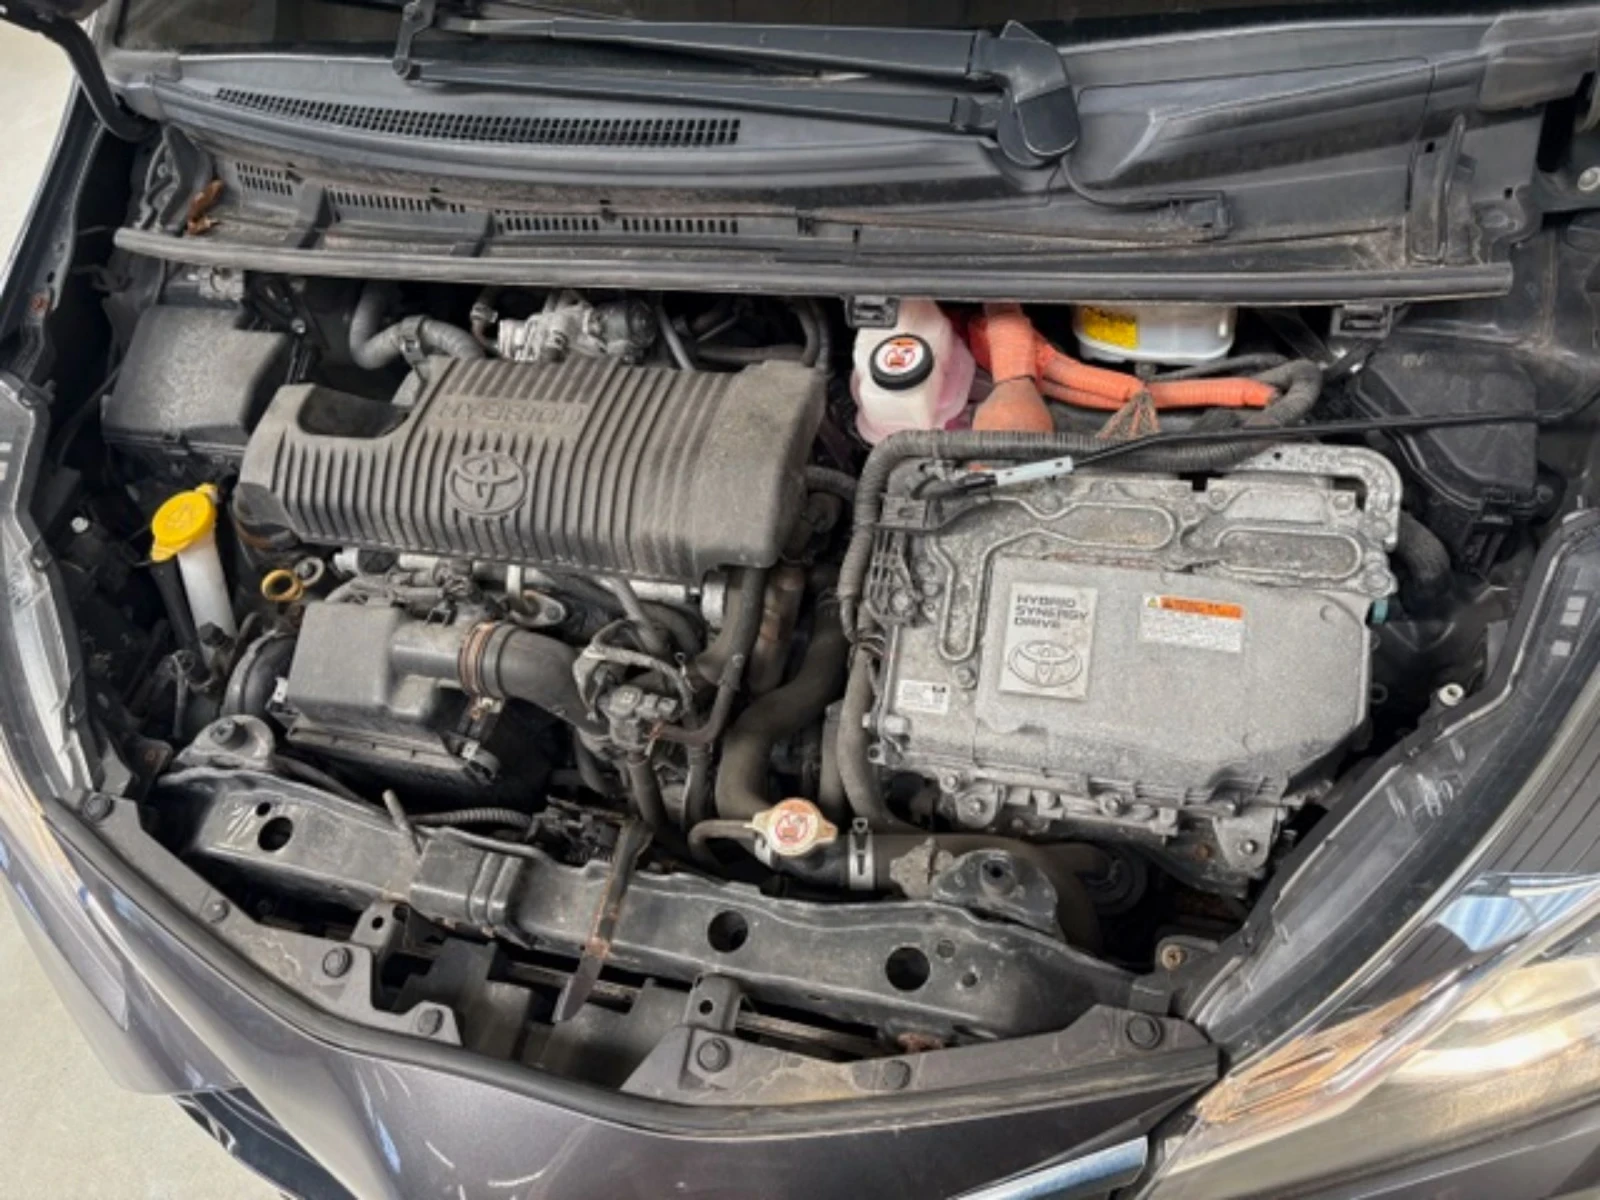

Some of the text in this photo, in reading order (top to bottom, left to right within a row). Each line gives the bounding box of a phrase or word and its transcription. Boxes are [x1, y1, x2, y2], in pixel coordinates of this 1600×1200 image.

[438, 401, 585, 425] HYBRID
[1017, 594, 1076, 608] HYBRID
[1015, 605, 1088, 620] SYNERGY
[1014, 616, 1061, 629] DRIVE
